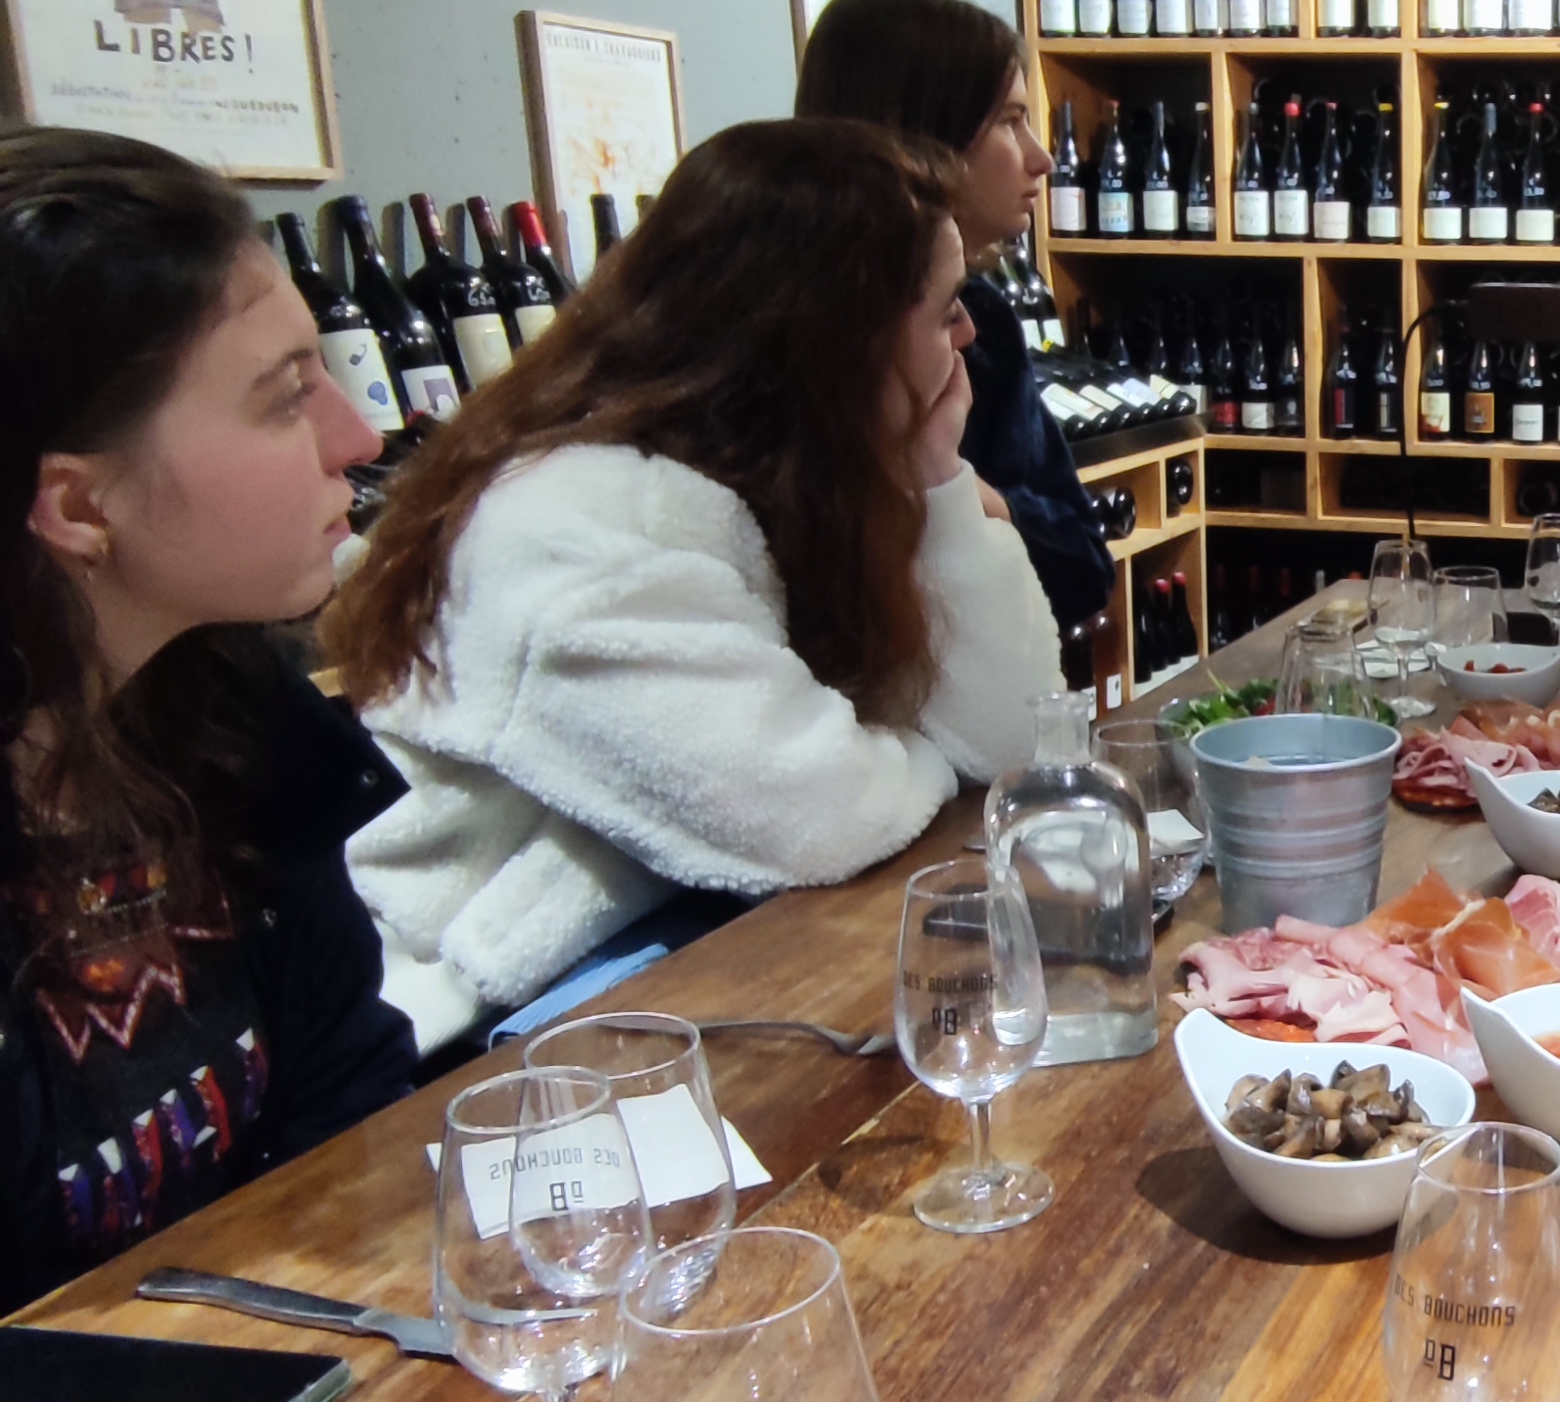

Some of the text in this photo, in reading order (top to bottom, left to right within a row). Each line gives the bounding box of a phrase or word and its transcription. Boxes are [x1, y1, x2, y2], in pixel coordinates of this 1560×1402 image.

[93, 19, 255, 75] LIBRES!
[1394, 1274, 1516, 1328] DES BOUCHONS
